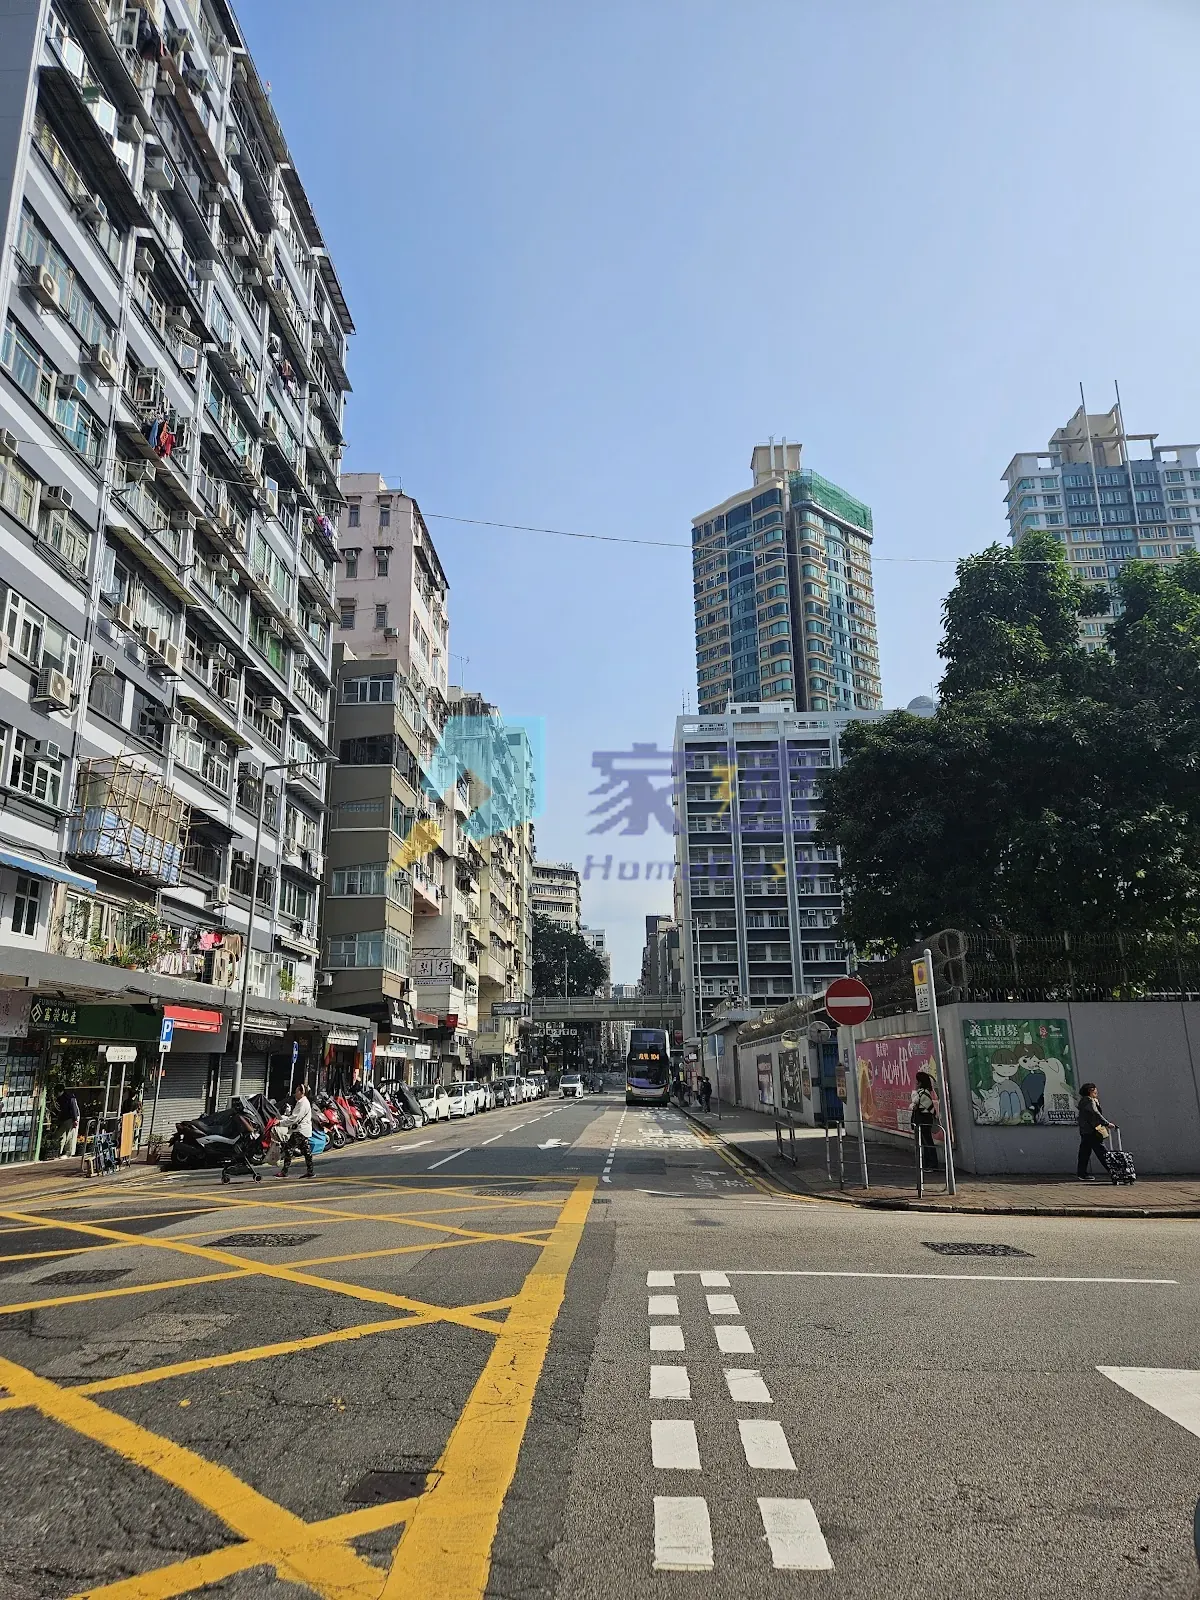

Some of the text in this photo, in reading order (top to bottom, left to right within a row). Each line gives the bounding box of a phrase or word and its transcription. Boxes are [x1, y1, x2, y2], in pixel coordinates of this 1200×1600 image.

[44, 1006, 77, 1025] 富榮地產
[163, 1021, 172, 1040] P
[969, 1024, 1019, 1038] 義工招募
[650, 1053, 660, 1061] 104
